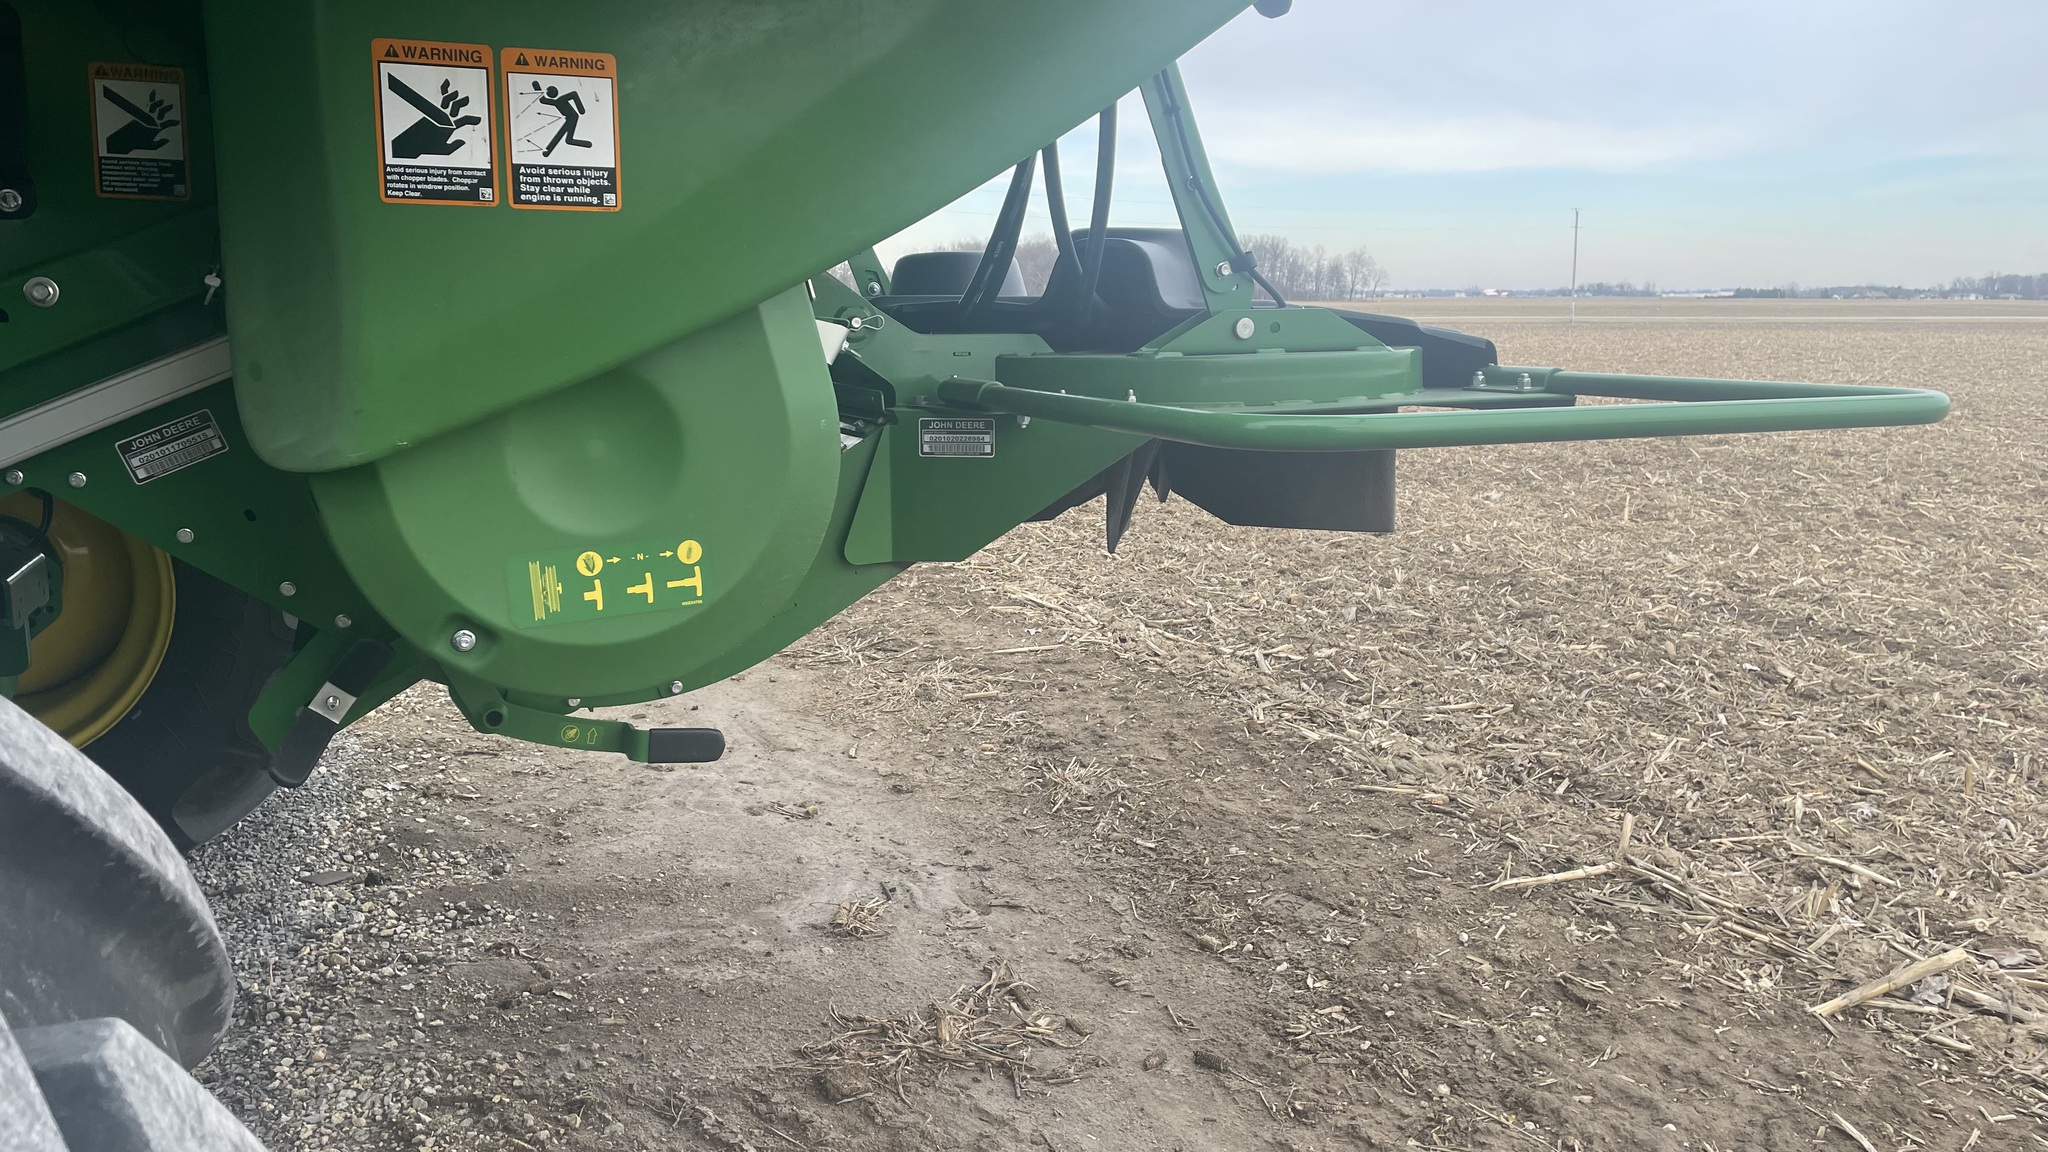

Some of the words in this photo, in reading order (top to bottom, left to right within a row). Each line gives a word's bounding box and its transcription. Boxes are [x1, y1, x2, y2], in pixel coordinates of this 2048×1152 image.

[402, 46, 482, 62] WARNING
[534, 55, 606, 70] WARNING
[110, 67, 180, 81] WARNING
[520, 166, 545, 174] Avoid
[548, 168, 581, 176] serious
[583, 168, 608, 178] injury
[520, 175, 540, 183] from
[543, 176, 574, 184] thrown
[576, 176, 611, 187] objects.
[520, 184, 540, 193] Stay
[543, 185, 564, 193] clear
[567, 185, 590, 194] while
[520, 193, 552, 203] engine
[553, 193, 561, 201] is
[563, 194, 601, 205] running.
[131, 432, 161, 450] JOHN
[163, 416, 202, 437] DEERE
